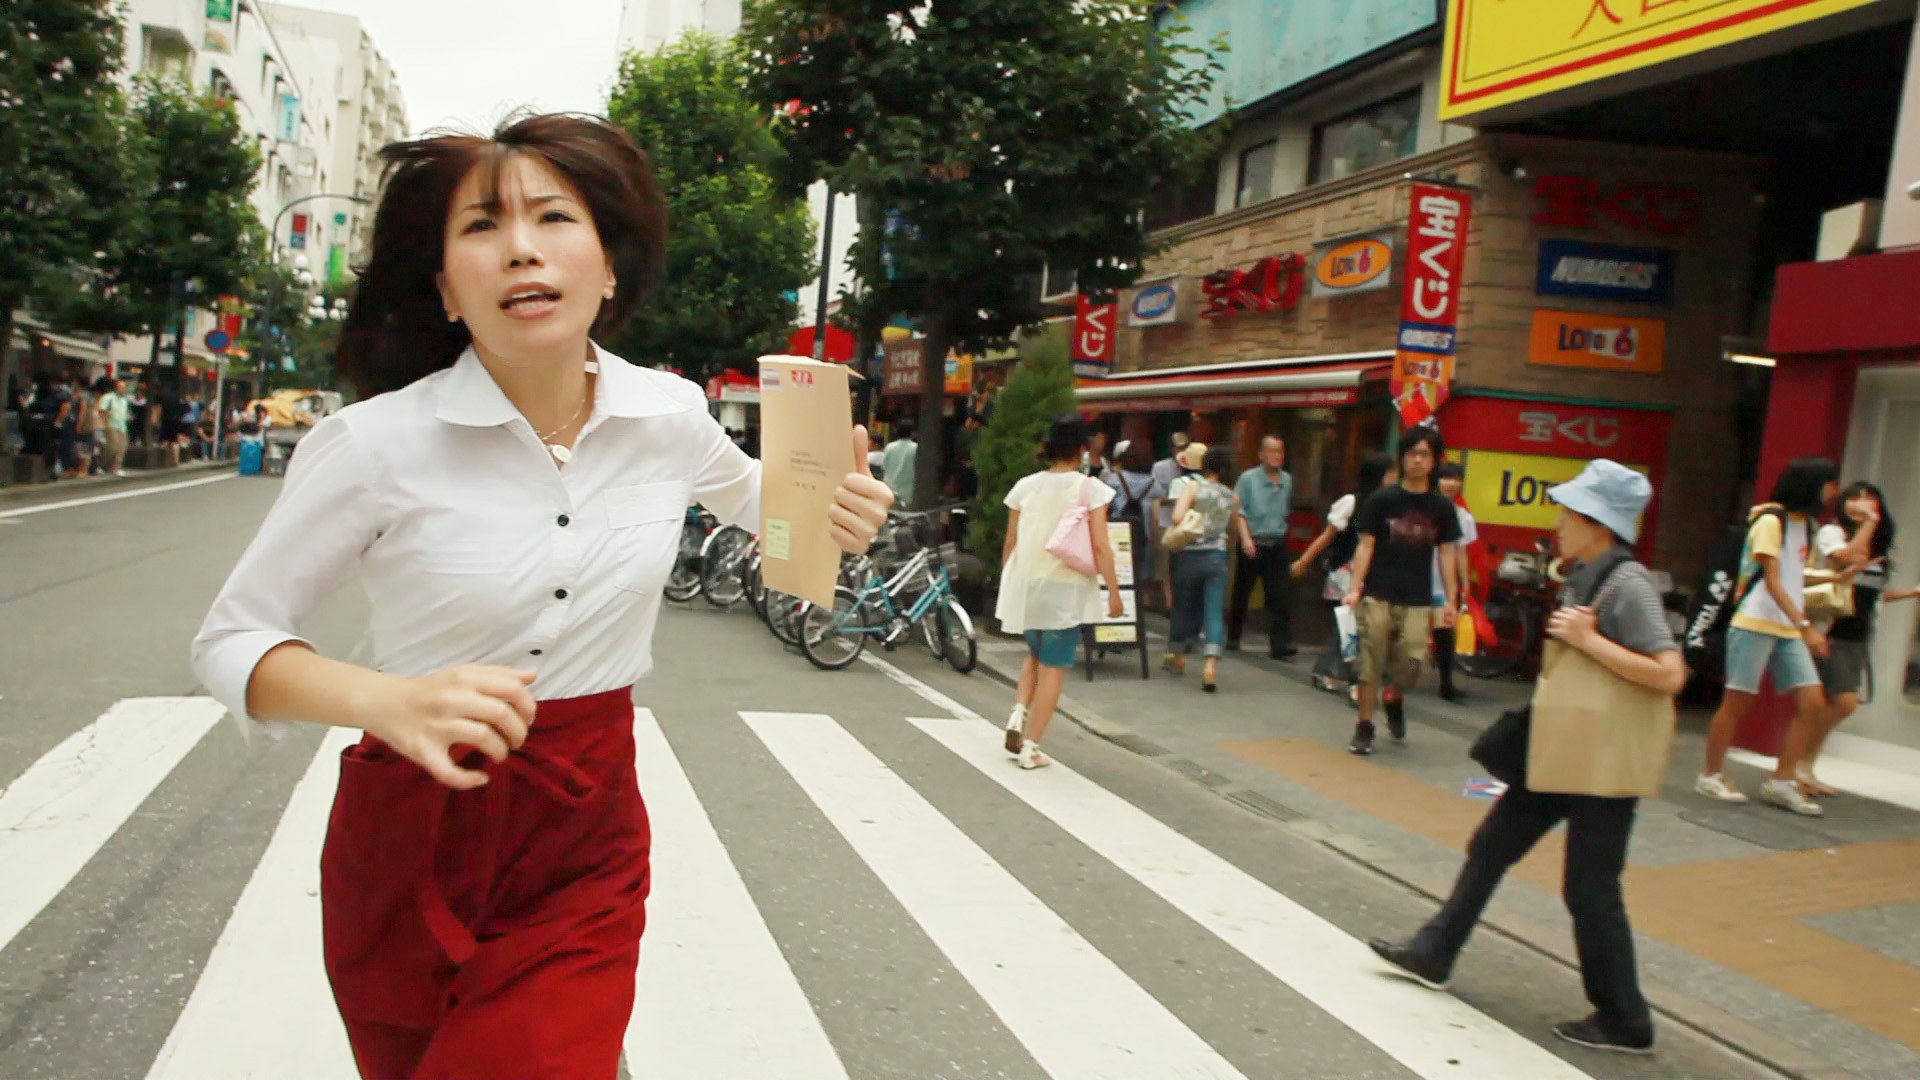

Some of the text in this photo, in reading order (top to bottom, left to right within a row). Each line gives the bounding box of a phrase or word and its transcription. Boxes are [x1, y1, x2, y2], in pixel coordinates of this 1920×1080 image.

[1412, 195, 1461, 319] 宝くじ
[1081, 296, 1109, 357] くじ
[1613, 325, 1634, 356] 6
[1519, 411, 1619, 446] 宝くじ
